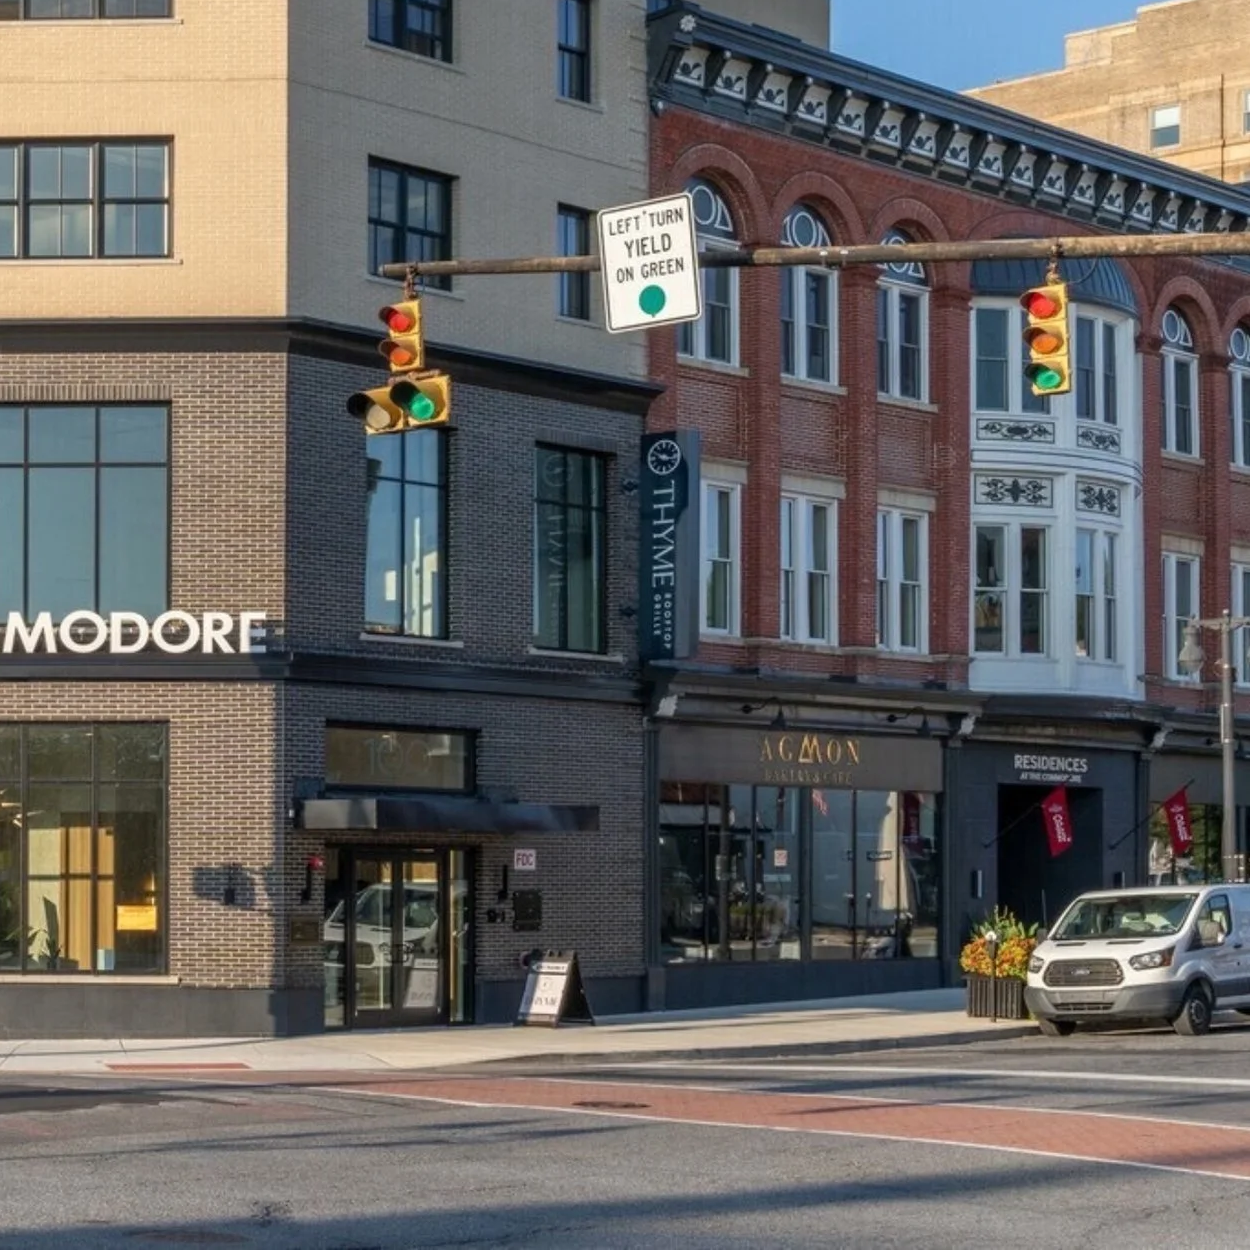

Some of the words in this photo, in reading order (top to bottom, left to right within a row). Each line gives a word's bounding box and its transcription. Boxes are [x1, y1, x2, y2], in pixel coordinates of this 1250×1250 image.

[608, 215, 640, 236] LEFT
[648, 207, 684, 228] TURN
[624, 233, 672, 258] YIELD
[616, 267, 634, 283] ON
[641, 257, 684, 279] GREEN
[651, 480, 675, 588] THYME
[653, 594, 661, 636] GRILLE
[664, 593, 672, 649] ROOFTOP
[1014, 754, 1088, 773] RESIDENCES
[516, 853, 534, 866] FDC
